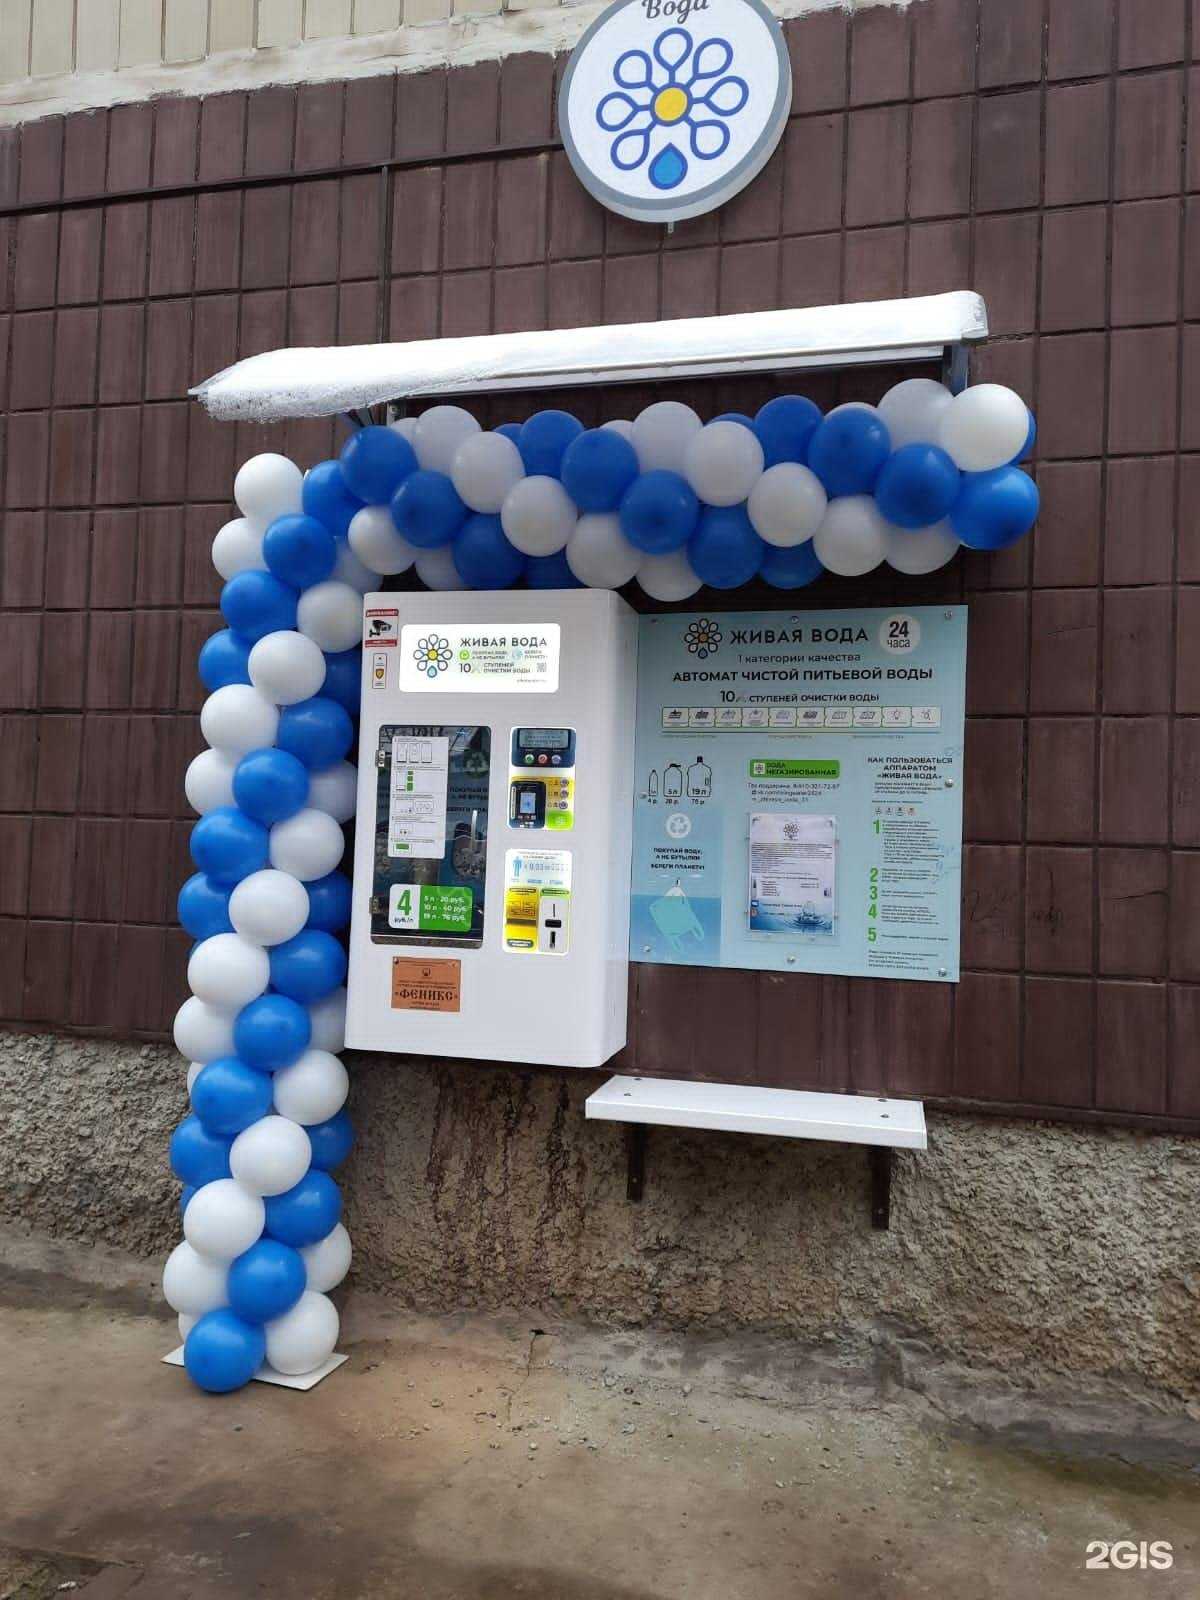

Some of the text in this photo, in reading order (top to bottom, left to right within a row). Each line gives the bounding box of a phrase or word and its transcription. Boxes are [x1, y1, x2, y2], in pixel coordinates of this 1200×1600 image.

[730, 626, 869, 645] ЖИВАЯ ВОДА
[888, 620, 909, 638] 24
[460, 637, 547, 648] ЖИВАЯ ВОДА
[886, 638, 911, 649] часа
[745, 654, 805, 664] категории
[808, 653, 861, 662] качества
[460, 663, 472, 673] 10
[673, 667, 933, 682] АВТОМАТ ЧИСТОЙ ПИТЬЕВОЙ ВОДЫ
[720, 690, 880, 703] 10 СТУПЕНЕЙ ОЧИСТКИ ВОДЫ
[766, 768, 837, 776] НЕГАЗИРОВАННАЯ
[873, 819, 880, 834] 1
[869, 867, 879, 883] 2
[869, 885, 878, 900] 3
[397, 889, 412, 917] 4
[868, 904, 878, 919] 4
[867, 927, 877, 942] 5
